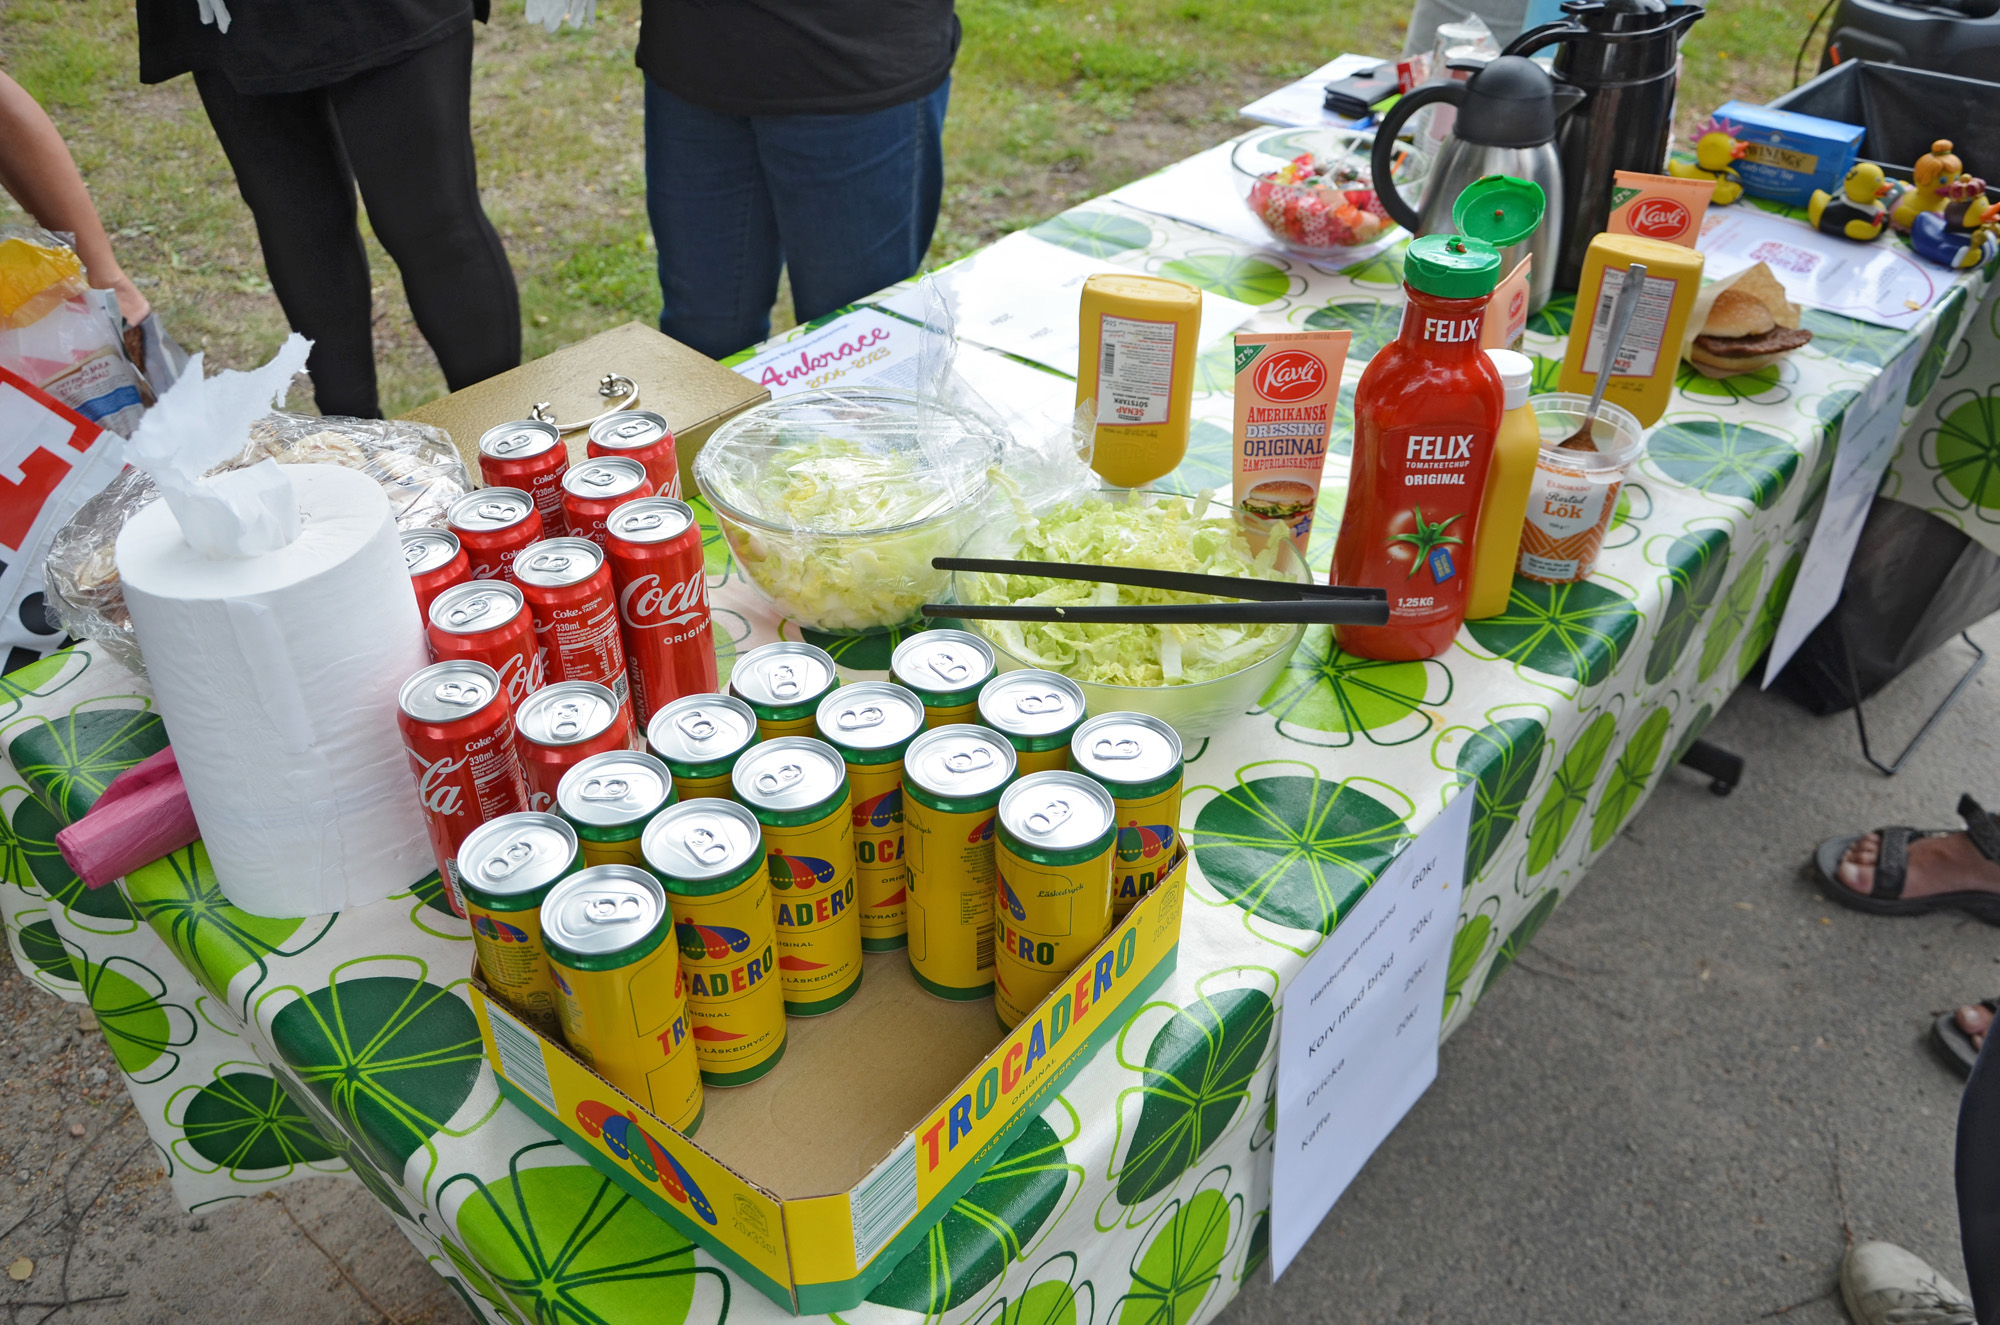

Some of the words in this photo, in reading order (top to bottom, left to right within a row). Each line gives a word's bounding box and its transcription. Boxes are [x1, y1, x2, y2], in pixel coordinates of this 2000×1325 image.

[1634, 204, 1685, 231] Kavli
[1424, 317, 1479, 343] FELIX
[760, 328, 890, 387] Ankrace
[1235, 347, 1254, 366] 17%
[1263, 359, 1320, 394] Kavli
[1114, 397, 1149, 408] SÖTSTARK
[1116, 405, 1145, 417] SENAP
[1247, 403, 1328, 424] AMERIKANSK
[1245, 422, 1326, 439] DRESSING
[1244, 438, 1325, 457] ORIGINAL
[1406, 434, 1474, 461] FELIX
[1405, 461, 1470, 470] TOMATKETCHUP
[535, 485, 556, 498] 330ml
[1404, 474, 1466, 487] ORIGINAL
[1543, 500, 1584, 519] Lök
[1545, 491, 1588, 504] Rostad
[555, 620, 580, 633] 330ml
[630, 655, 642, 680] MIG
[468, 749, 495, 766] 330ml
[773, 877, 853, 927] ADERO
[1037, 883, 1085, 898] Läskedryck
[1310, 948, 1359, 1006] Hamburgare
[1360, 924, 1378, 949] med
[1379, 904, 1396, 928] bröd
[1411, 856, 1438, 890] 60kr
[786, 961, 850, 985] LÄSKEDRYCK
[1308, 1020, 1336, 1058] Korv
[1339, 985, 1365, 1024] med
[1367, 952, 1394, 991] bröd
[1409, 909, 1434, 944] 20kr
[704, 1031, 771, 1054] LÄSKEDRYCK
[922, 926, 1137, 1174] TROCADERO
[1011, 1058, 1057, 1106] ORIGINAL
[1306, 1058, 1345, 1107] Dricka
[973, 1107, 1026, 1165] KOLSYRAD
[1028, 1043, 1089, 1108] LÄSKEDRYCK
[1301, 1112, 1331, 1151] Kaffe
[732, 1217, 777, 1256] 20x33cl
